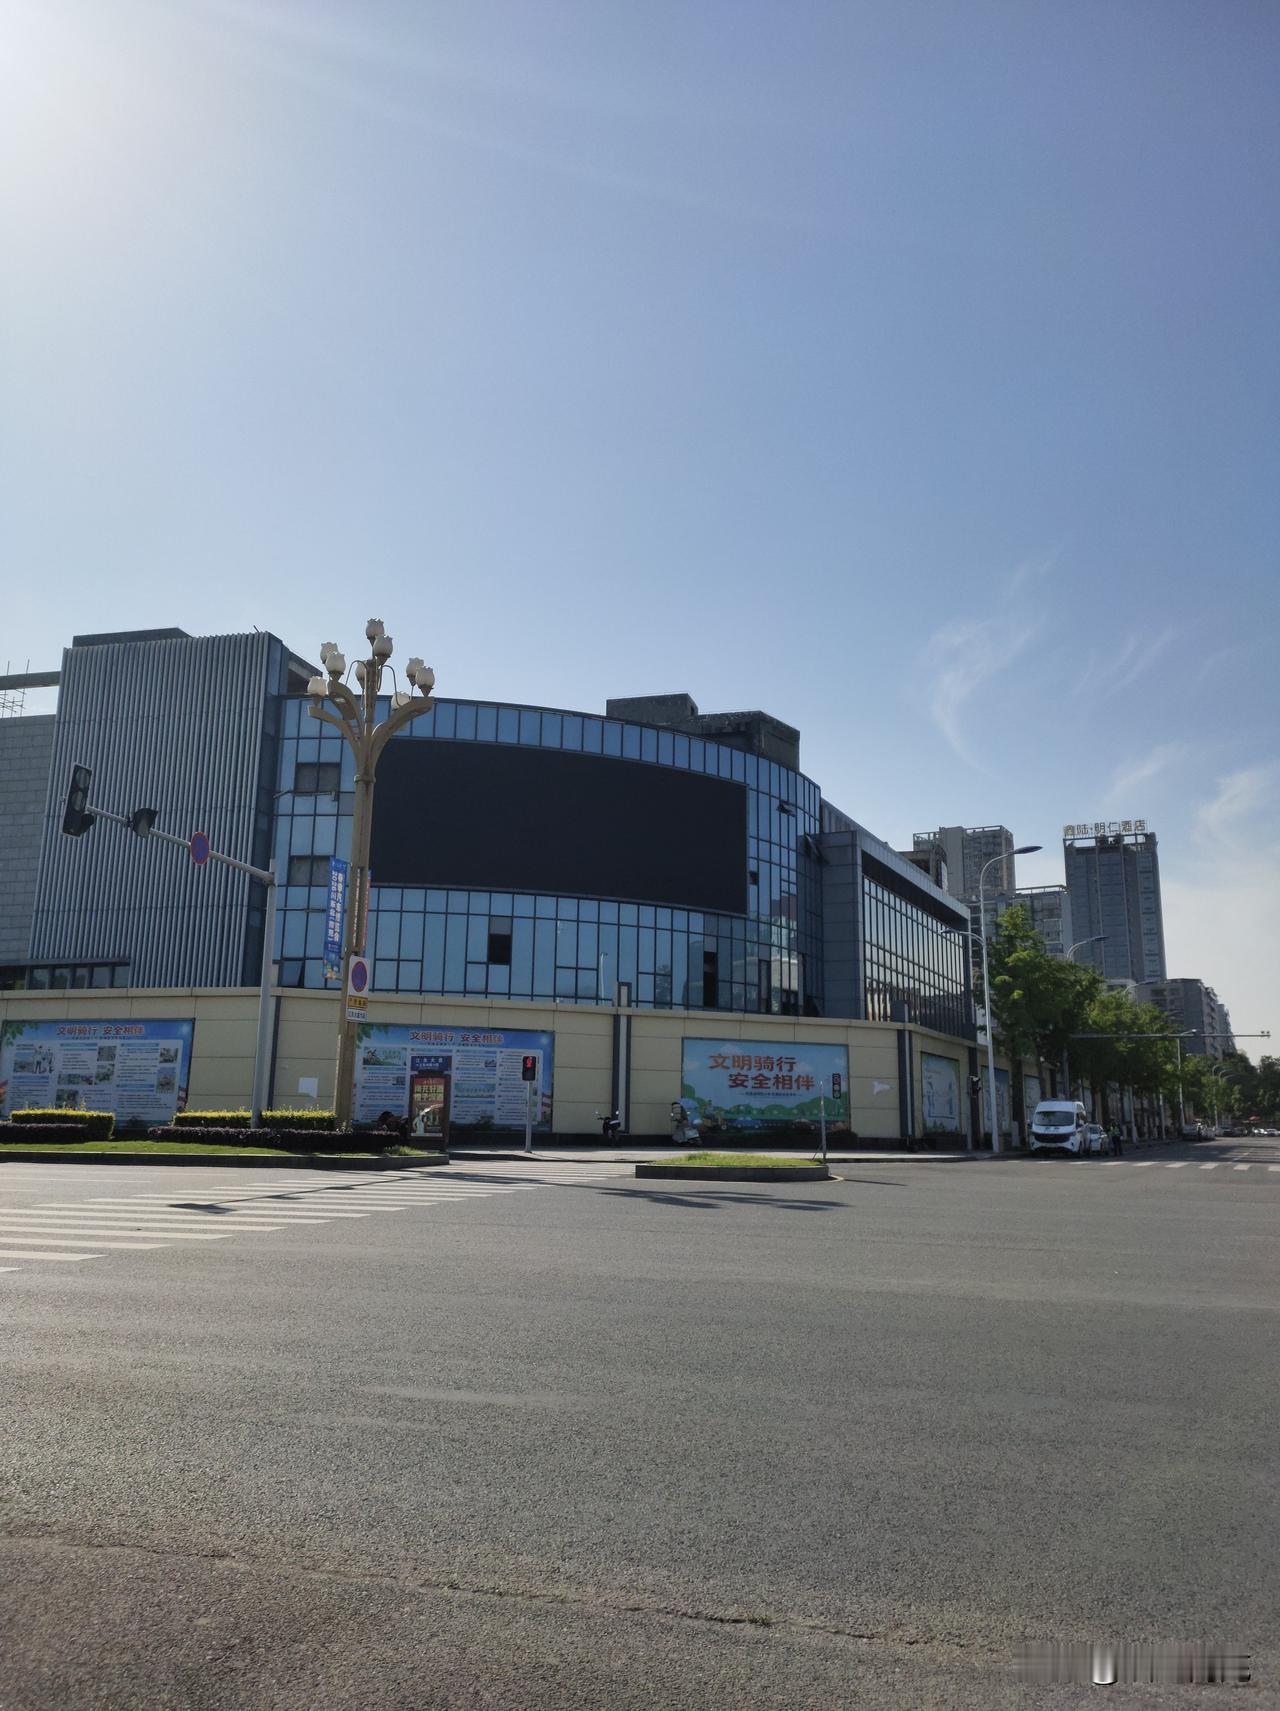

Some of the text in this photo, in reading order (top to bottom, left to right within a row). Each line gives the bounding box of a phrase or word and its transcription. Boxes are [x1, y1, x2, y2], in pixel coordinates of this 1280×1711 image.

[57, 1025, 145, 1036] 文明骑行 安全相伴
[409, 1031, 454, 1042] 文明骑行
[460, 1033, 505, 1044] 安全相伴
[708, 1053, 797, 1072] 文明骑行
[728, 1073, 816, 1090] 安全相伴
